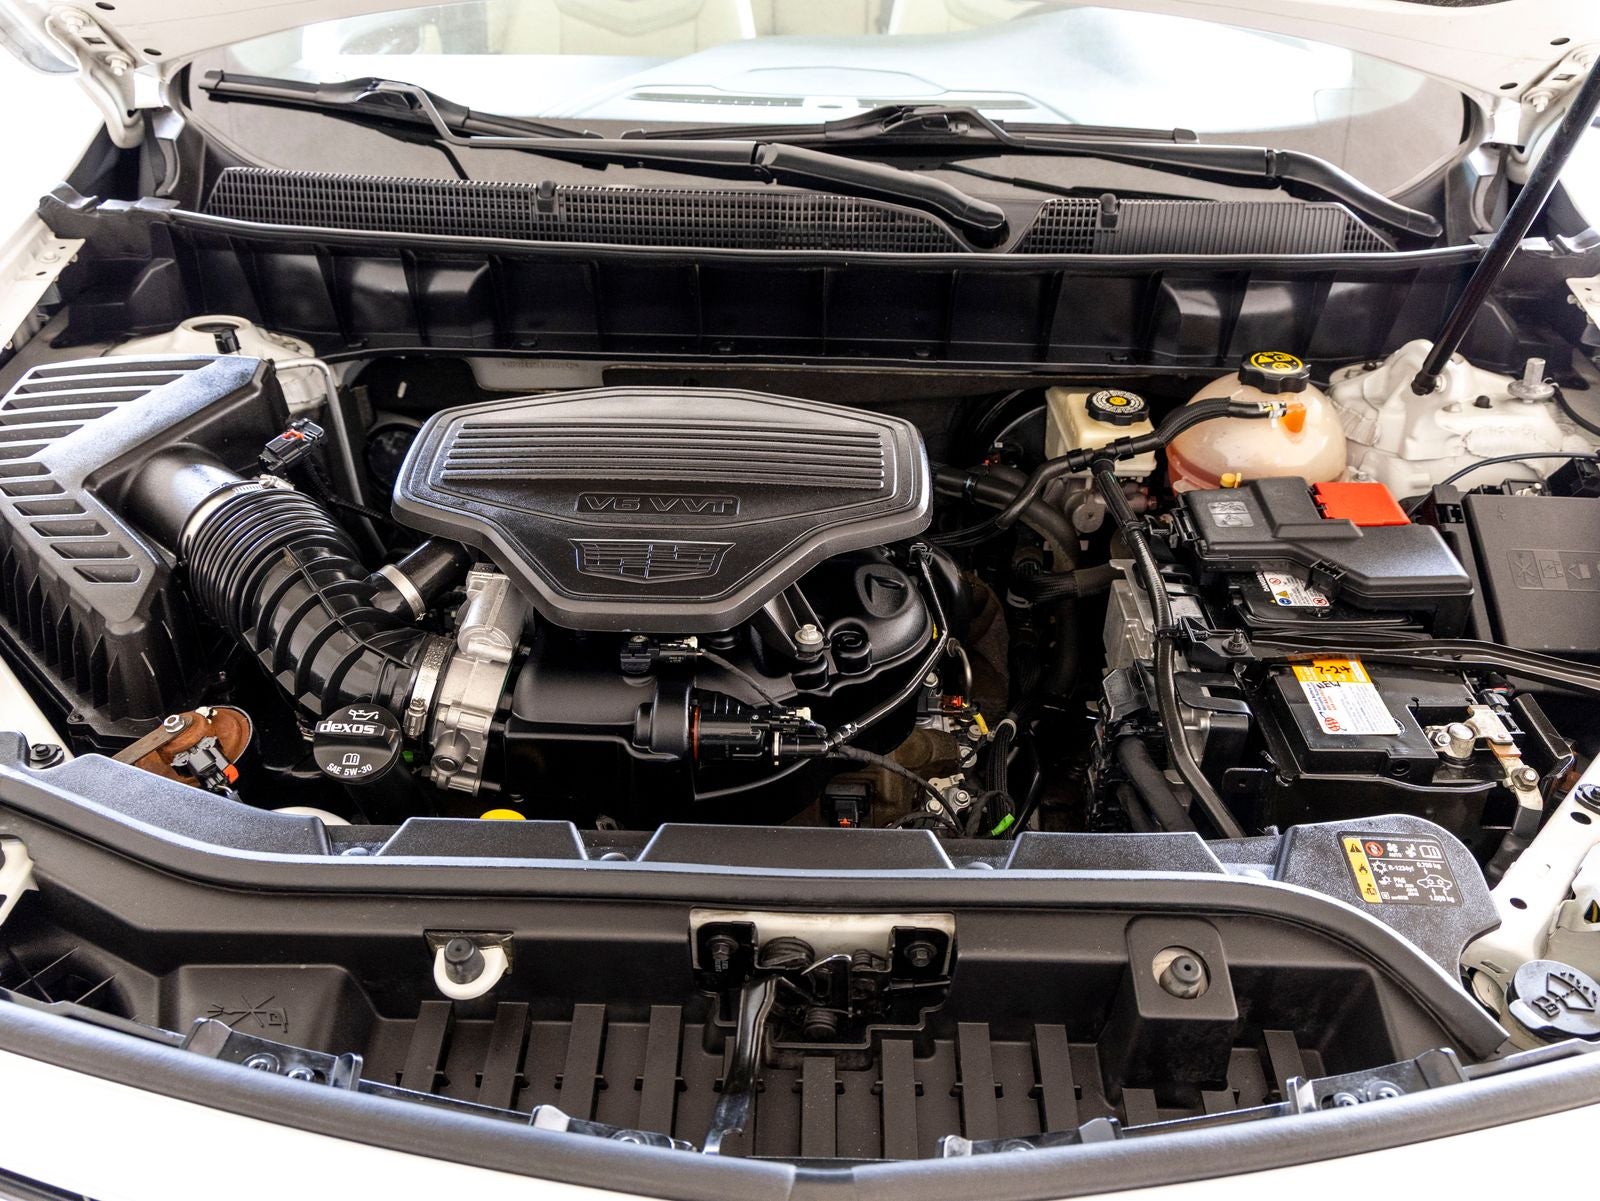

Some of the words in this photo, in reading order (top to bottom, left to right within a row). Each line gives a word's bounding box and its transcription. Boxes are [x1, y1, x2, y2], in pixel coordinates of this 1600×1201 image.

[584, 496, 641, 511] V6
[649, 497, 733, 513] VVT
[1315, 665, 1351, 675] 7-24
[1316, 680, 1341, 689] NEW
[320, 721, 377, 734] dexos
[326, 762, 343, 775] SAE
[343, 763, 373, 776] 5W-30
